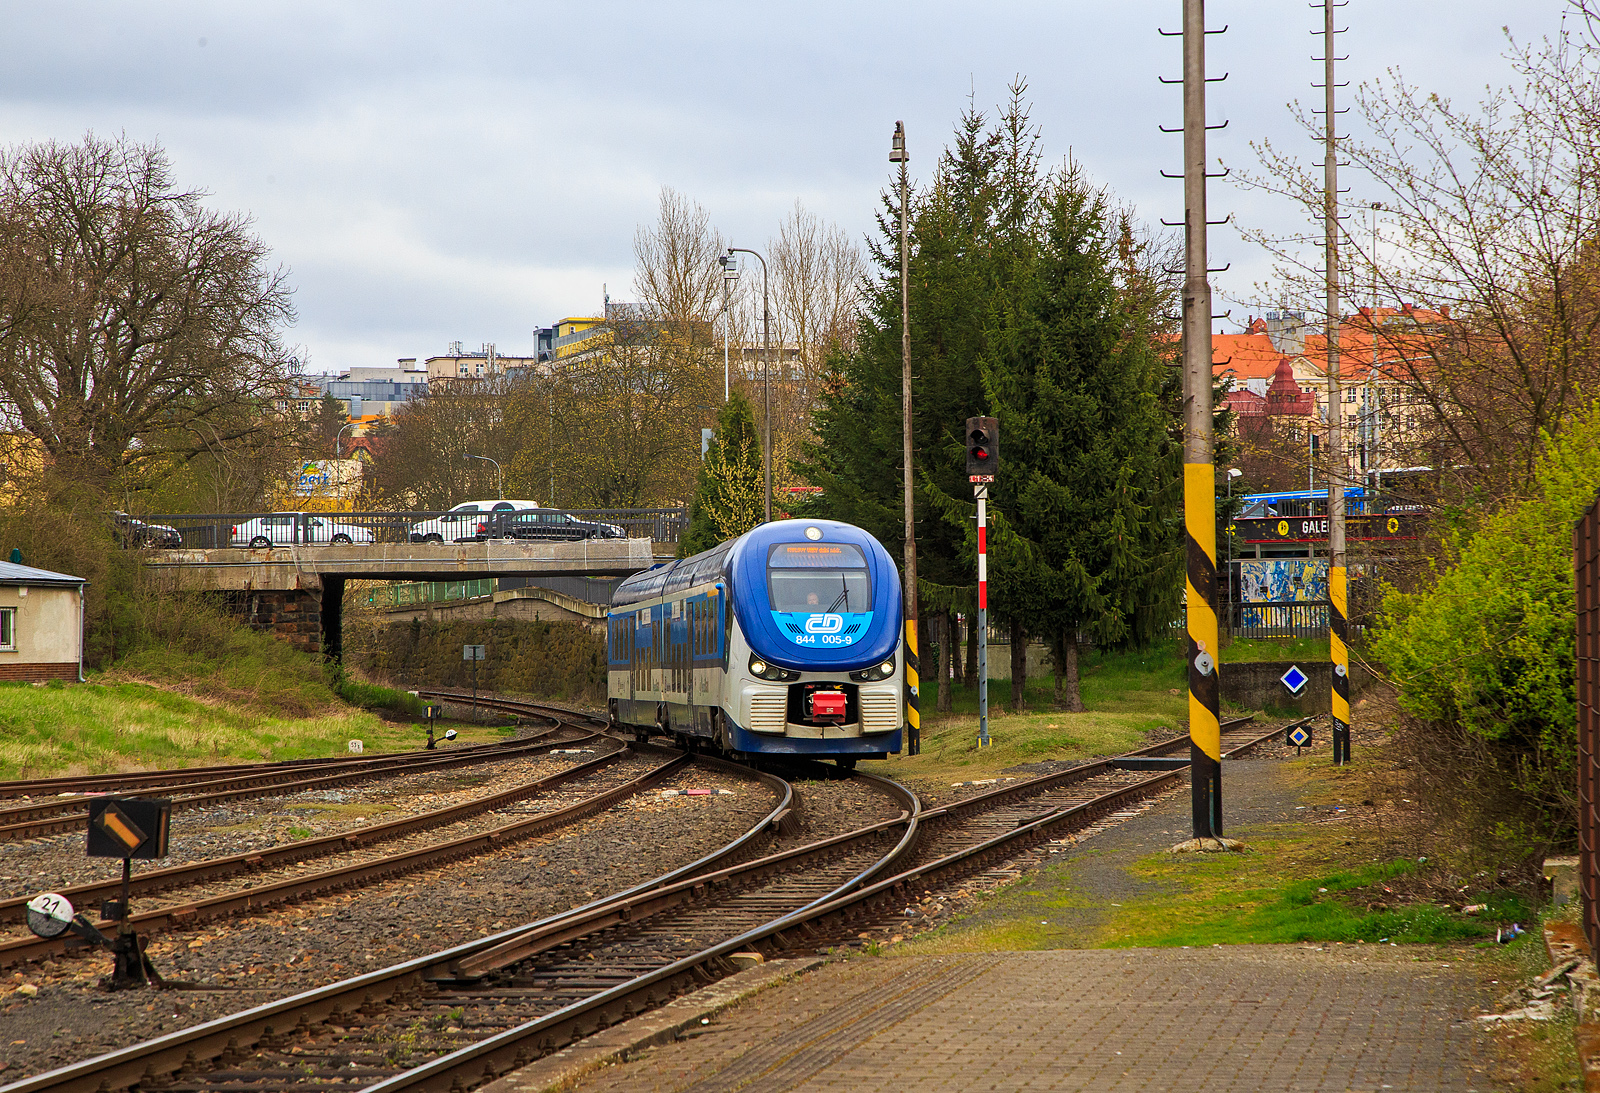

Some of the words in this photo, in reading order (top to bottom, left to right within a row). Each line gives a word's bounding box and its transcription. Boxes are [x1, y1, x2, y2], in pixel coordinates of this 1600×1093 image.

[1302, 520, 1329, 533] GALE
[796, 635, 815, 644] 844
[822, 635, 852, 644] 005-9
[42, 897, 60, 914] 21
